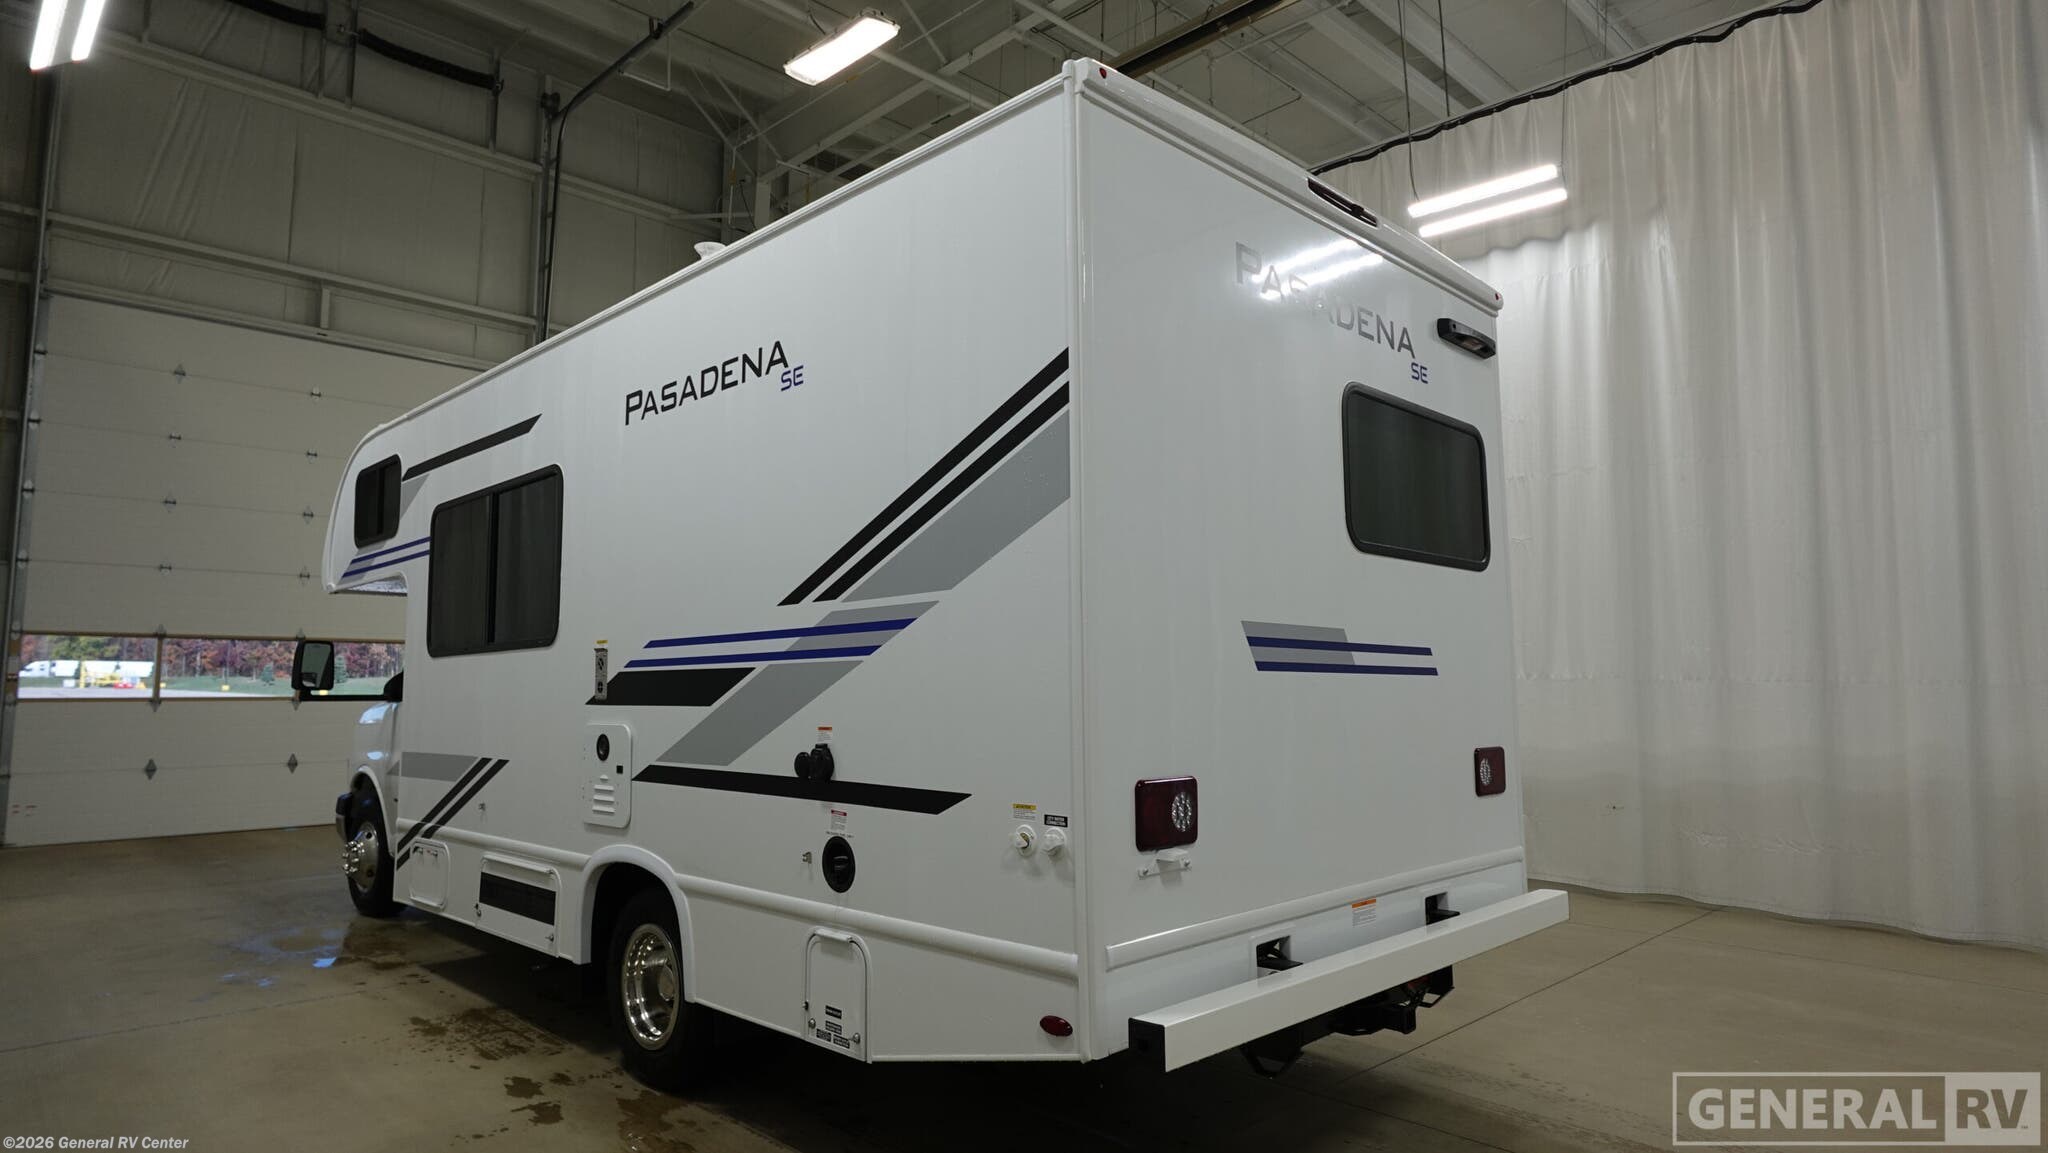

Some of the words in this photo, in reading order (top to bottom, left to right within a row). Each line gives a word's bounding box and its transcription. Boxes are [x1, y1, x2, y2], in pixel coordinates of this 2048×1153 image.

[1235, 241, 1416, 359] PADENA
[625, 340, 789, 426] PASADENA
[780, 365, 804, 392] SE
[1411, 362, 1429, 384] SE
